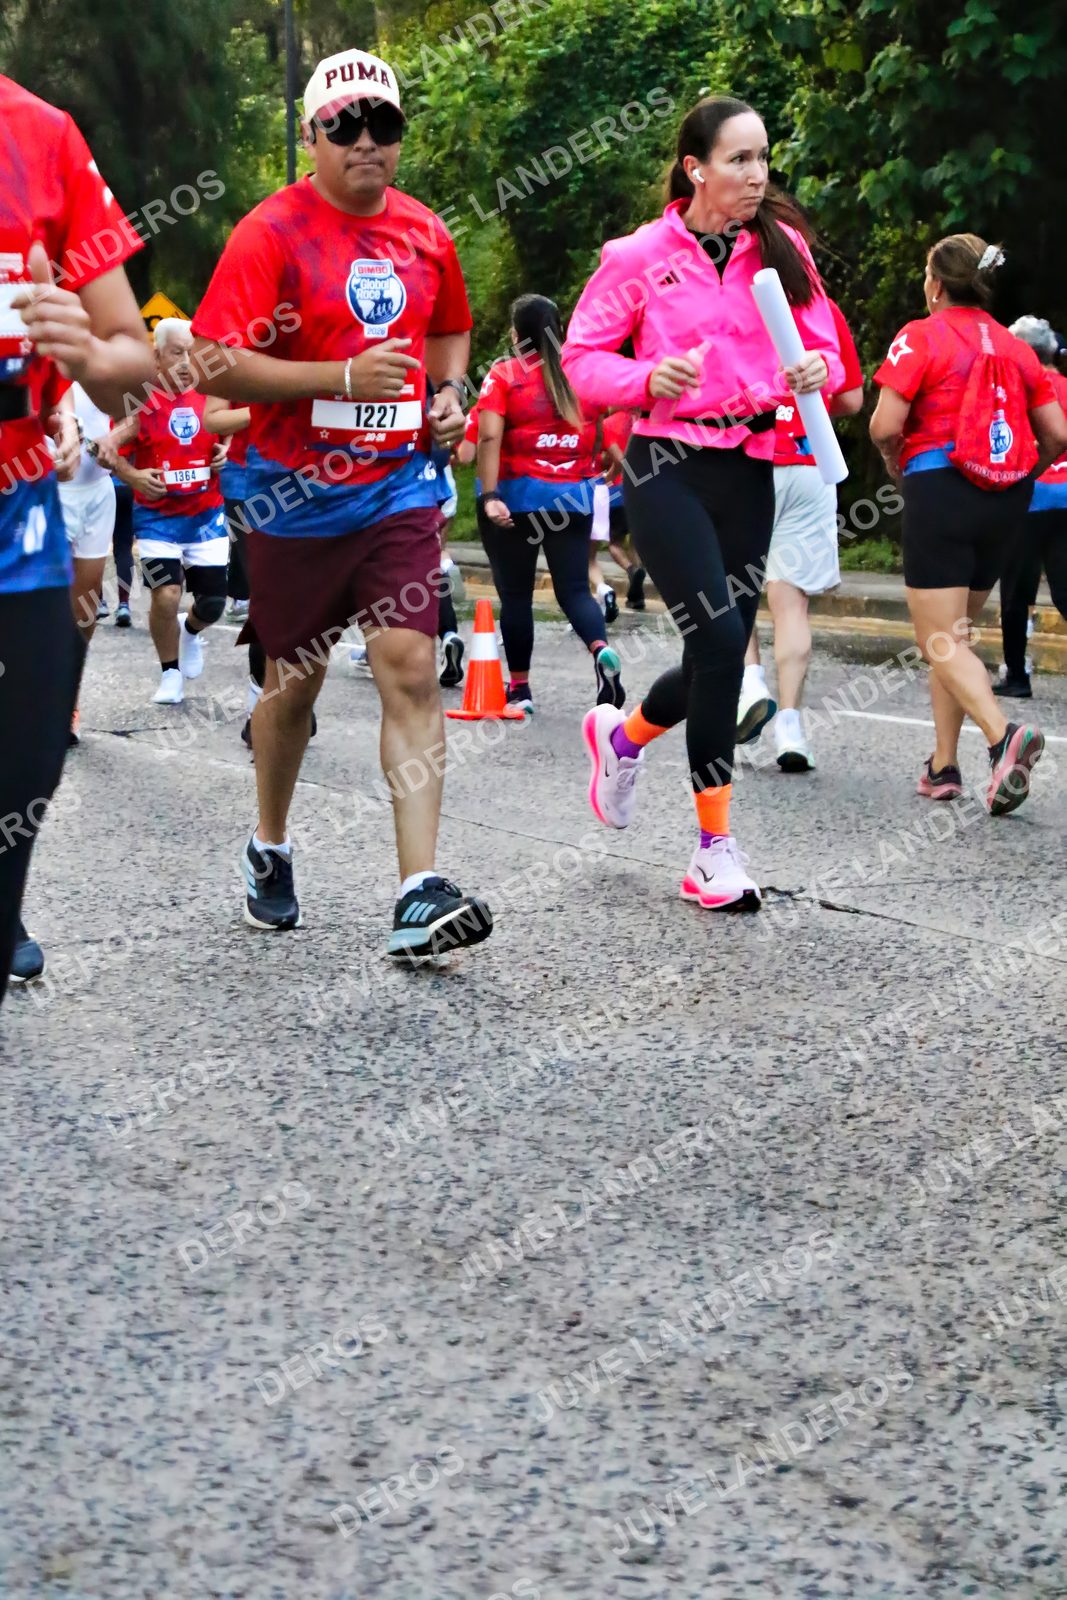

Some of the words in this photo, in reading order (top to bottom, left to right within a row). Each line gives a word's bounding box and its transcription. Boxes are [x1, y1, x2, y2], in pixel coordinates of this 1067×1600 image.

[325, 61, 391, 89] PUMA
[357, 265, 388, 274] BIMBO
[360, 279, 390, 290] Global
[356, 289, 381, 300] Race
[354, 404, 398, 428] 1227
[536, 433, 579, 448] 20-26
[174, 470, 196, 482] 1364
